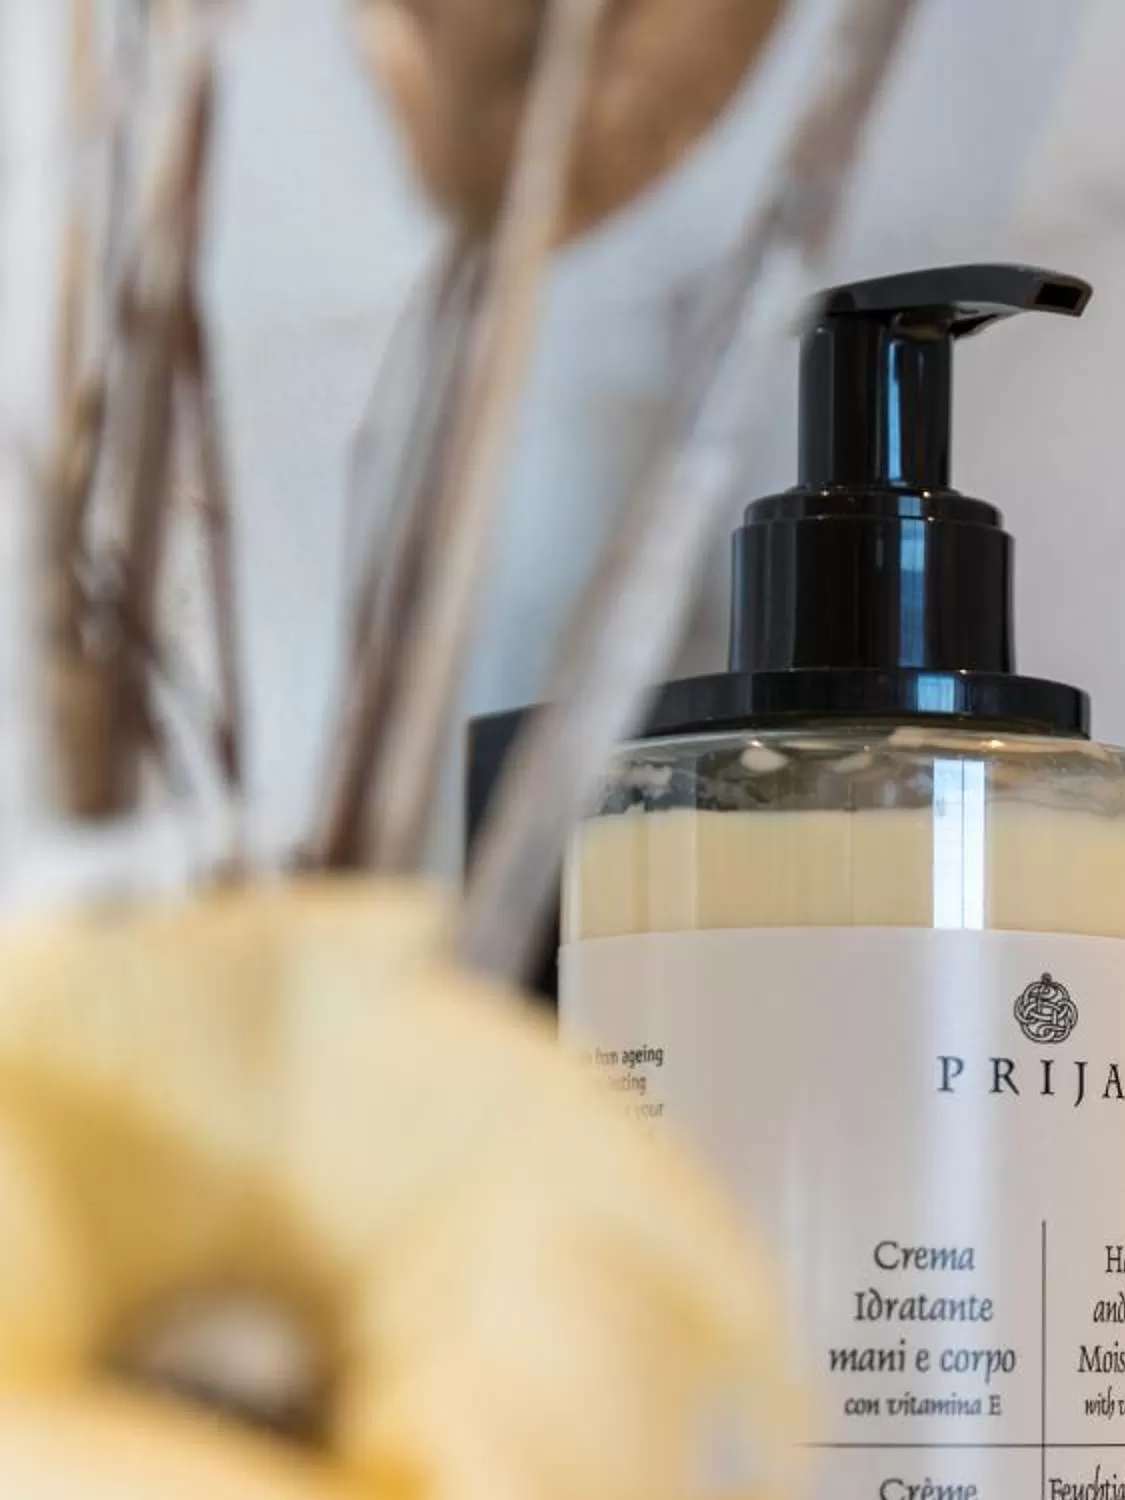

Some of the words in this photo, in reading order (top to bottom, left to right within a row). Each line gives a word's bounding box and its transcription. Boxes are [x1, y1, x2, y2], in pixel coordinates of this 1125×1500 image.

[622, 1044, 664, 1070] ageing
[937, 1056, 1125, 1107] PRIJA
[874, 1241, 976, 1271] Crema
[854, 1288, 994, 1322] Idratante
[829, 1340, 906, 1373] mani
[915, 1349, 930, 1373] e
[940, 1347, 1017, 1383] corpo
[844, 1397, 880, 1416] con
[887, 1391, 982, 1416] vitamina
[988, 1394, 1003, 1416] E
[1085, 1385, 1115, 1420] with
